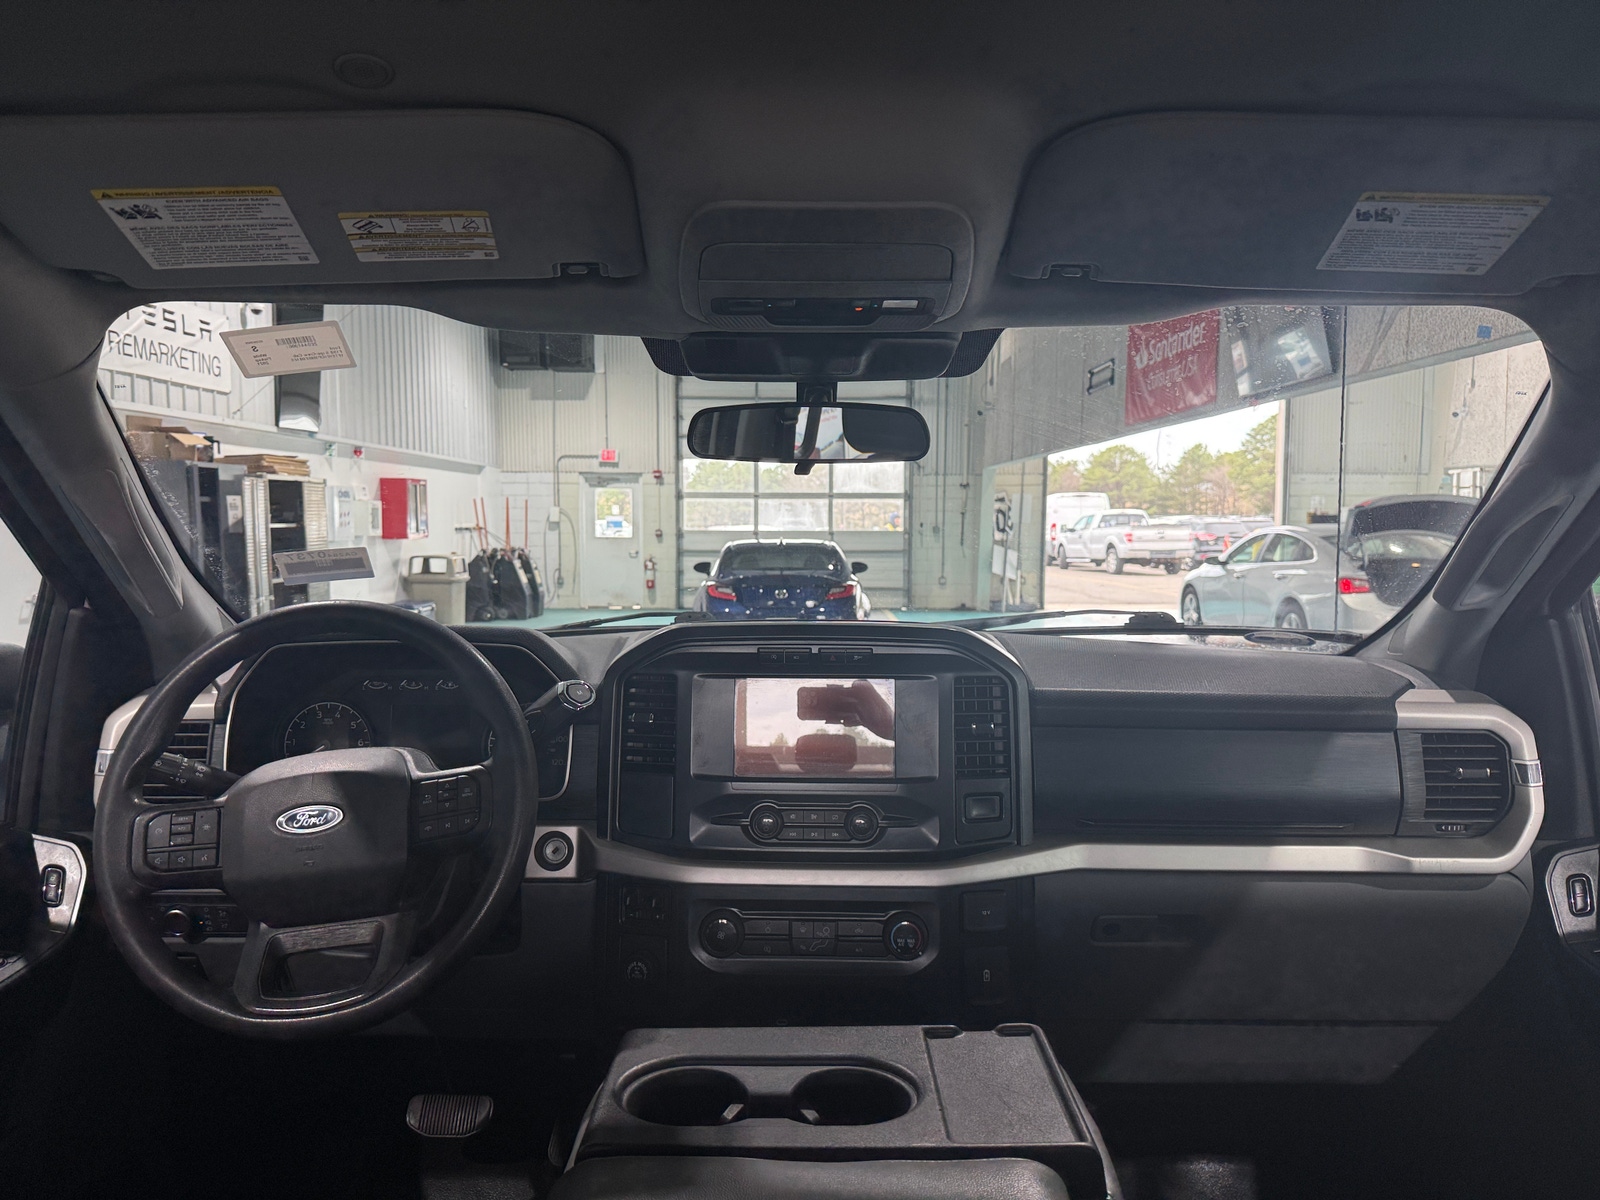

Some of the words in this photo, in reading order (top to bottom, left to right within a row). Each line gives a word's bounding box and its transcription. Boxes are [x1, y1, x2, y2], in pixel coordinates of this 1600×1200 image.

[1149, 320, 1206, 365] Santander
[108, 329, 222, 377] REMARKETING
[316, 711, 322, 719] 3
[335, 711, 341, 719] 4
[300, 721, 306, 729] 2
[350, 721, 357, 729] 5
[357, 739, 364, 747] 6
[293, 810, 327, 828] Ford
